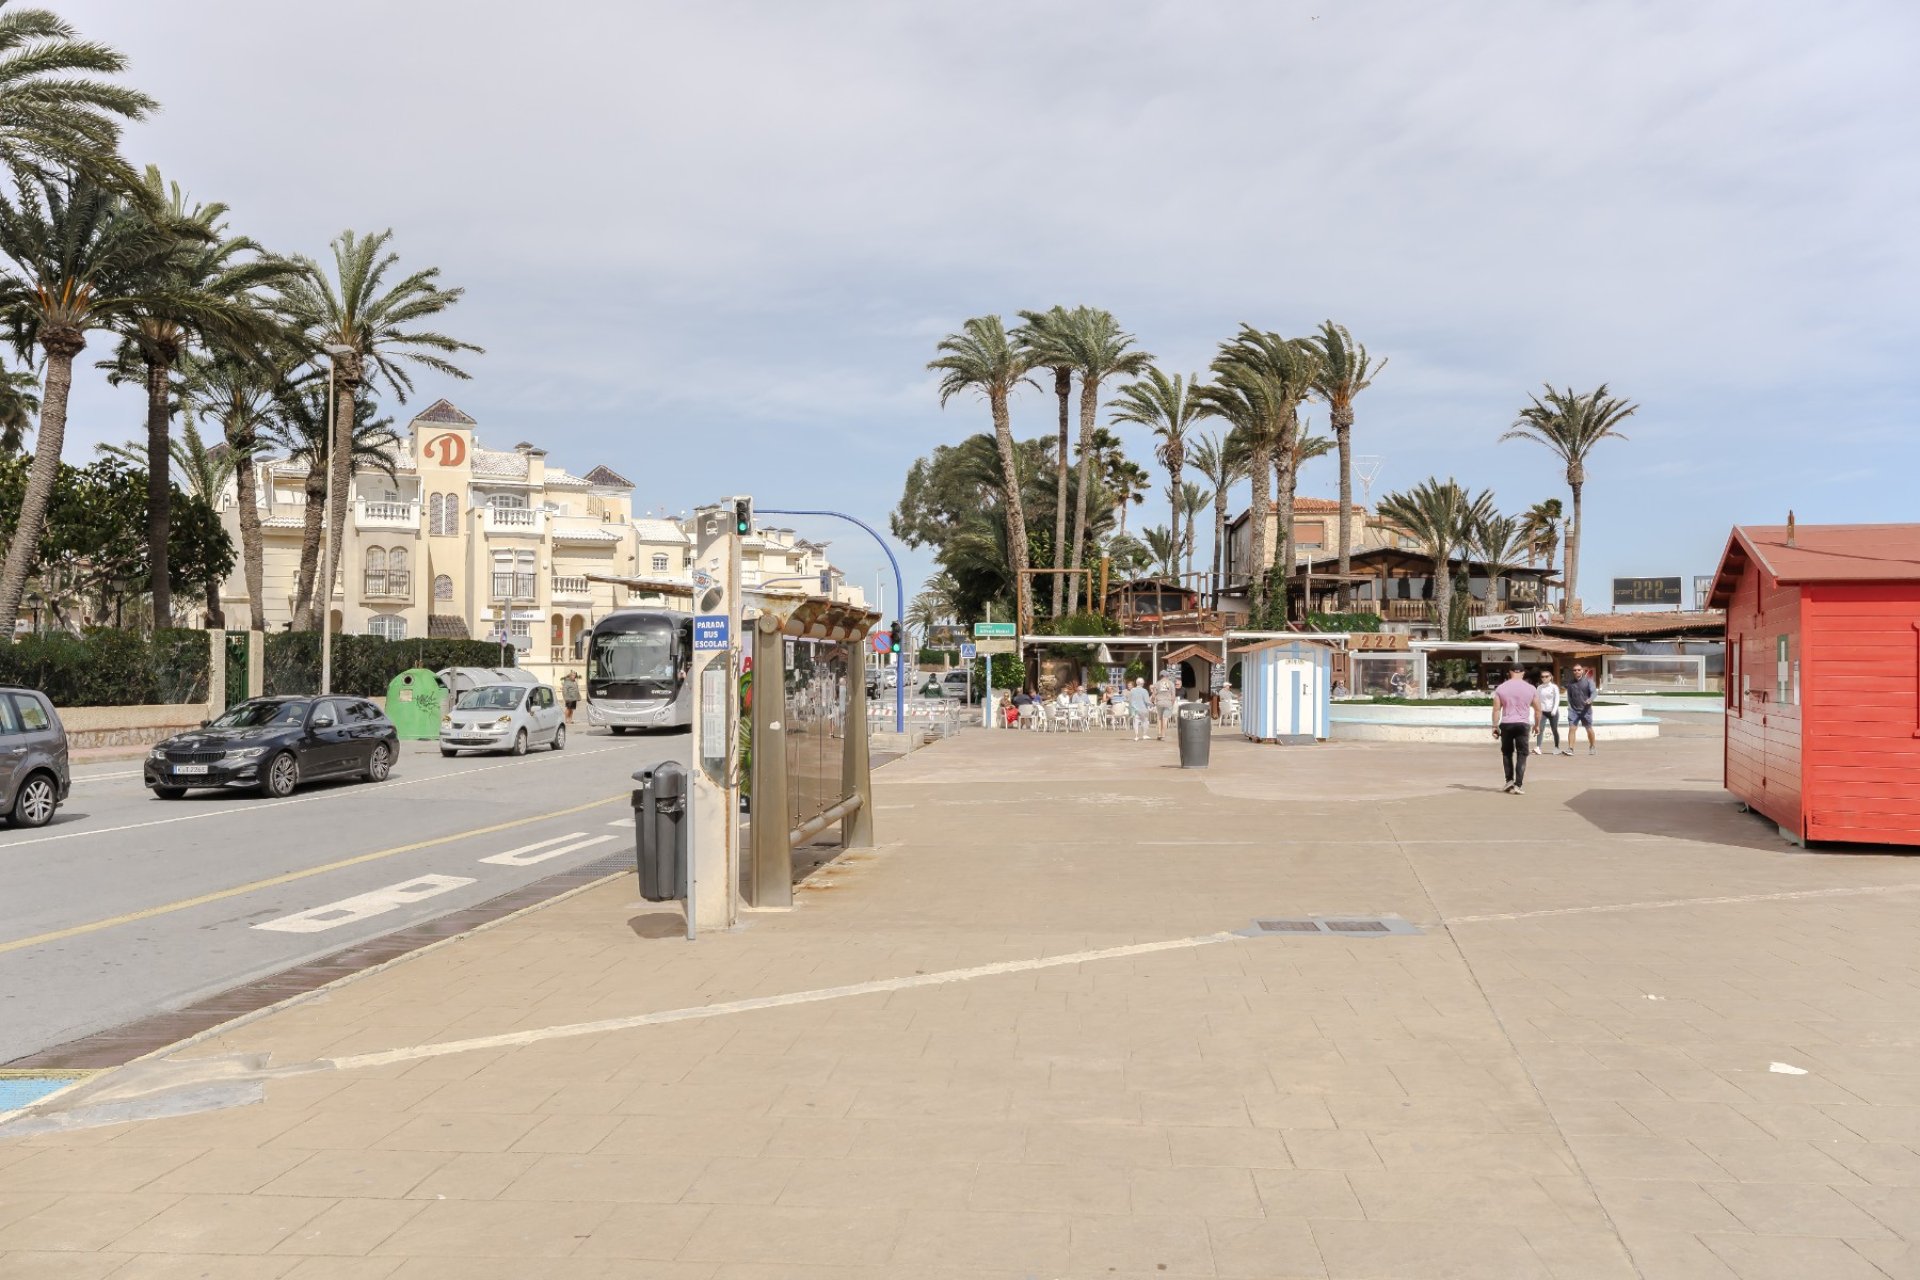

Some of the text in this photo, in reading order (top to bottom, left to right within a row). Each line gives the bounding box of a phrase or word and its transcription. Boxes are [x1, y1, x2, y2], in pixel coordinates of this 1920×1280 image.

[423, 432, 466, 467] D
[1633, 579, 1664, 600] 222
[697, 621, 725, 629] PARADA
[703, 630, 719, 639] BUS
[695, 640, 728, 648] ESCOLAR
[1361, 635, 1396, 648] 222
